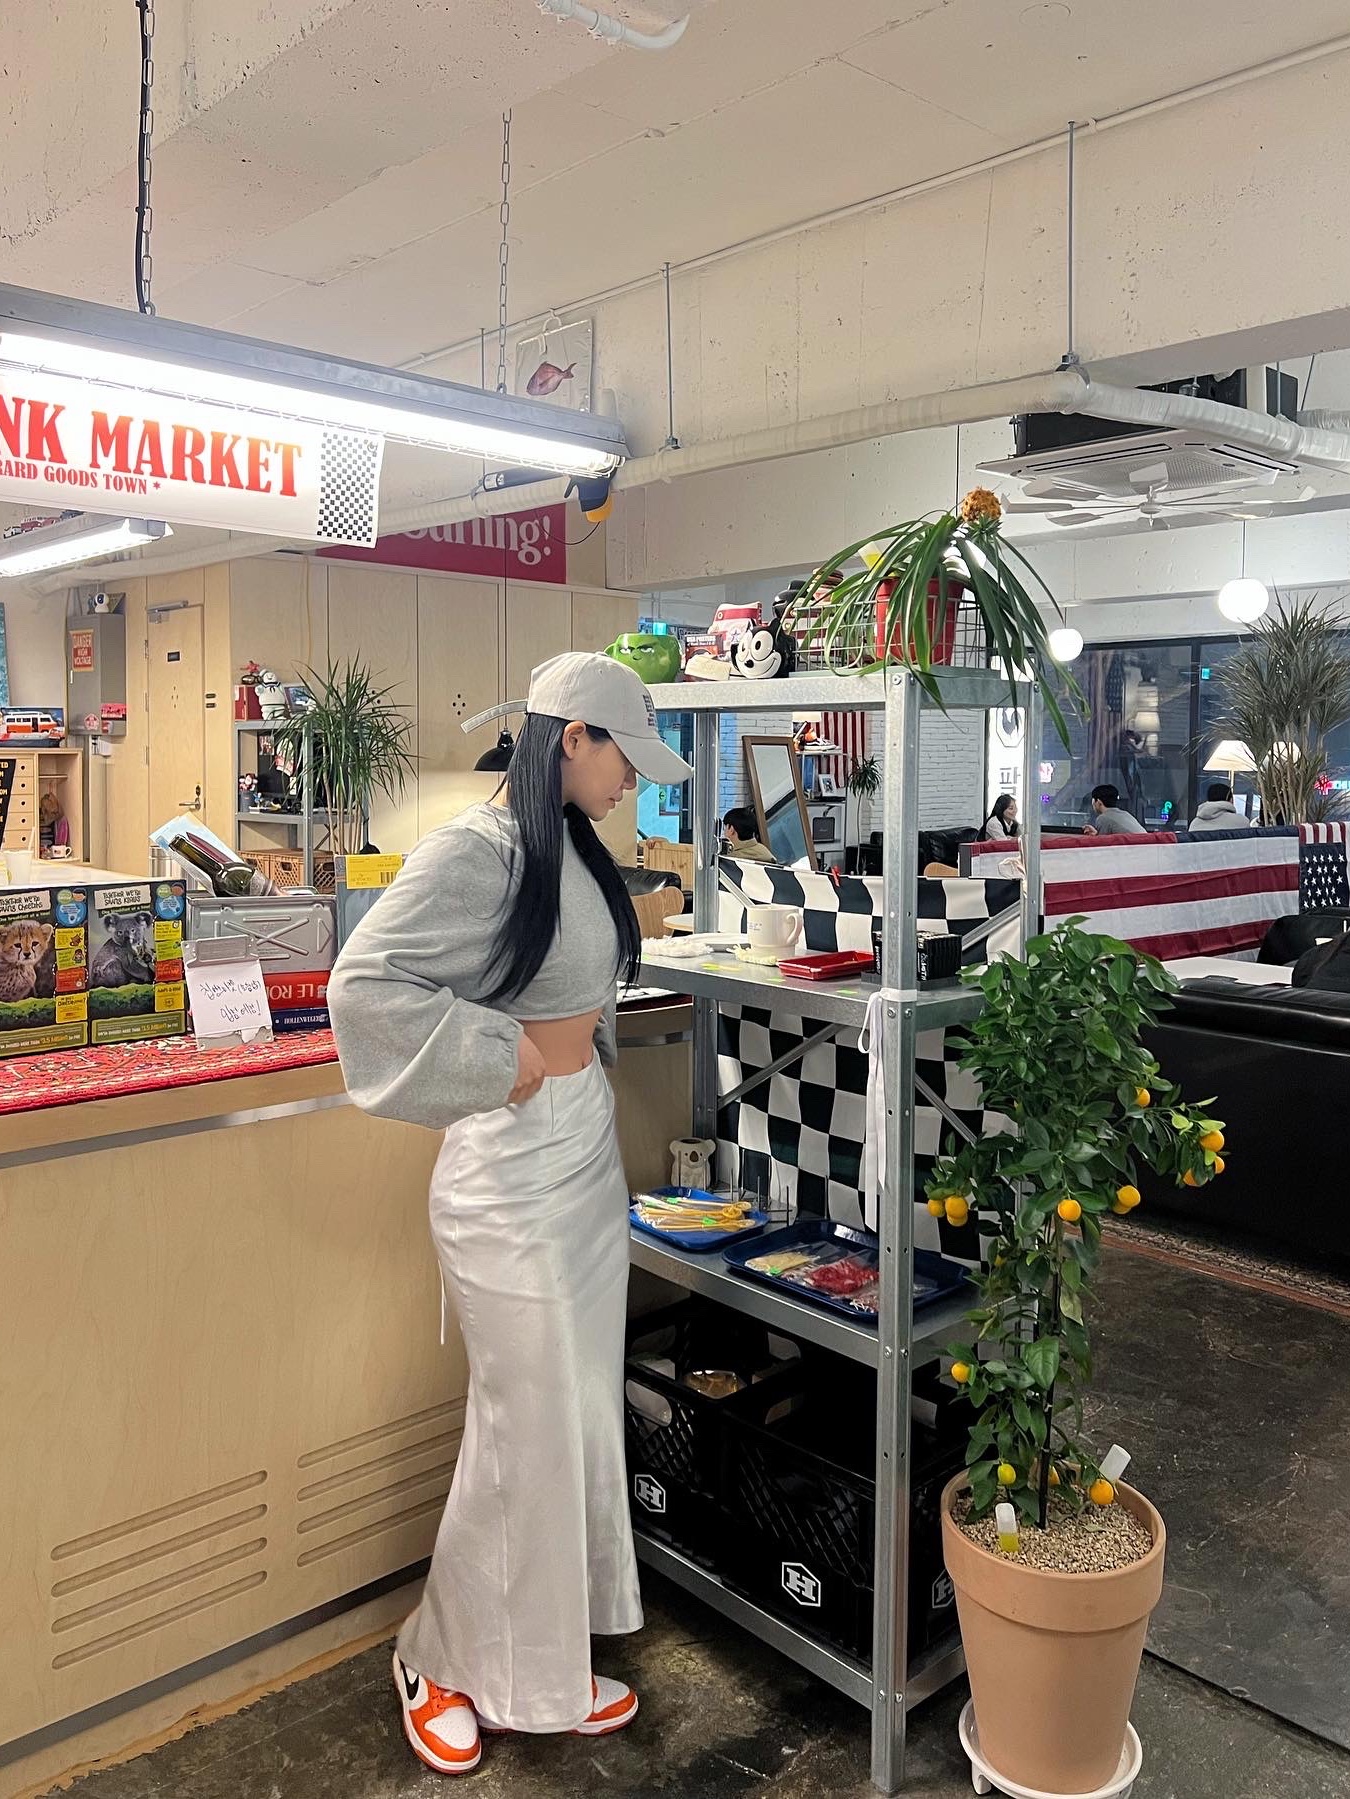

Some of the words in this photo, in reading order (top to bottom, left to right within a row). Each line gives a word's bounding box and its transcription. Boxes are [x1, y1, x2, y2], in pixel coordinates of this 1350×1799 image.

[90, 410, 303, 498] MARKET
[0, 459, 38, 480] ARD
[45, 465, 98, 489] GOODS
[103, 473, 148, 495] TOWN
[73, 656, 92, 665] VOLTAGE
[266, 983, 293, 1000] RO
[297, 983, 314, 998] LE
[636, 1478, 662, 1508] H
[786, 1565, 817, 1603] H
